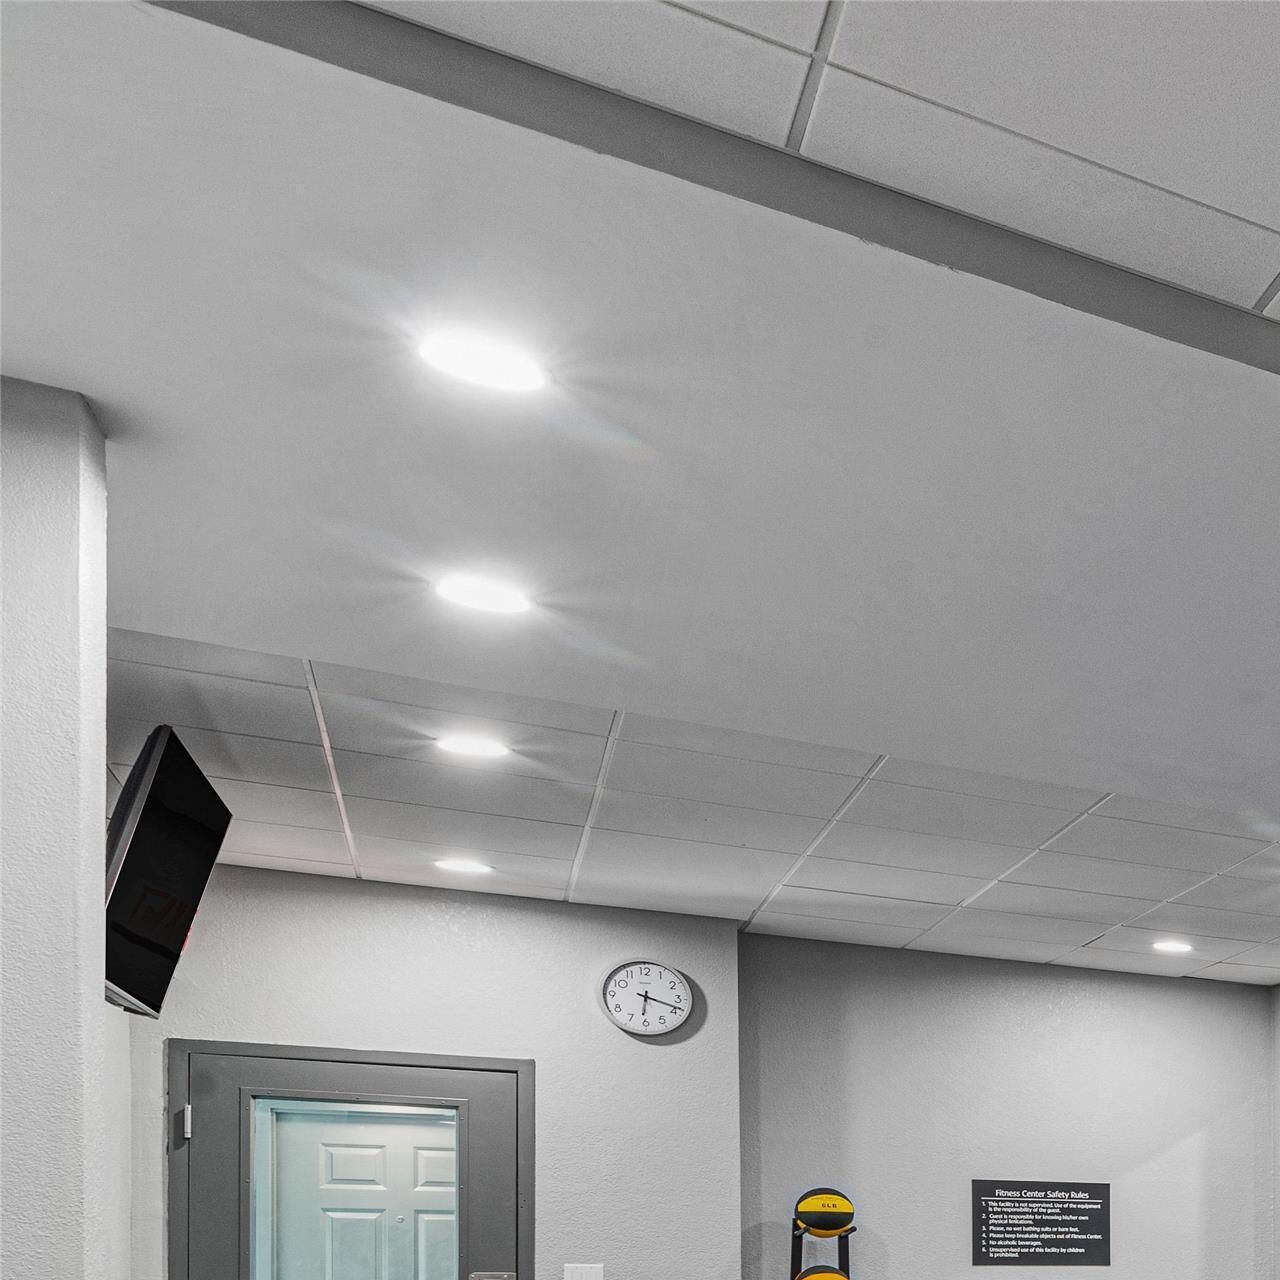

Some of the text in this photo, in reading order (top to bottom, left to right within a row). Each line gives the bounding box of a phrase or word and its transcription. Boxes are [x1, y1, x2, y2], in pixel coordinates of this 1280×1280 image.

[626, 970, 633, 979] 11
[640, 967, 650, 976] 12
[614, 979, 628, 988] 10
[669, 980, 676, 990] 2
[608, 990, 616, 999] 9
[674, 995, 682, 1003] 3
[614, 1004, 622, 1012] 8
[670, 1007, 677, 1015] 4
[627, 1013, 634, 1022] 7
[658, 1016, 666, 1024] 5
[642, 1018, 650, 1027] 6
[995, 1189, 1021, 1197] Fitness
[1021, 1190, 1046, 1198] Center
[1046, 1191, 1070, 1200] Safety
